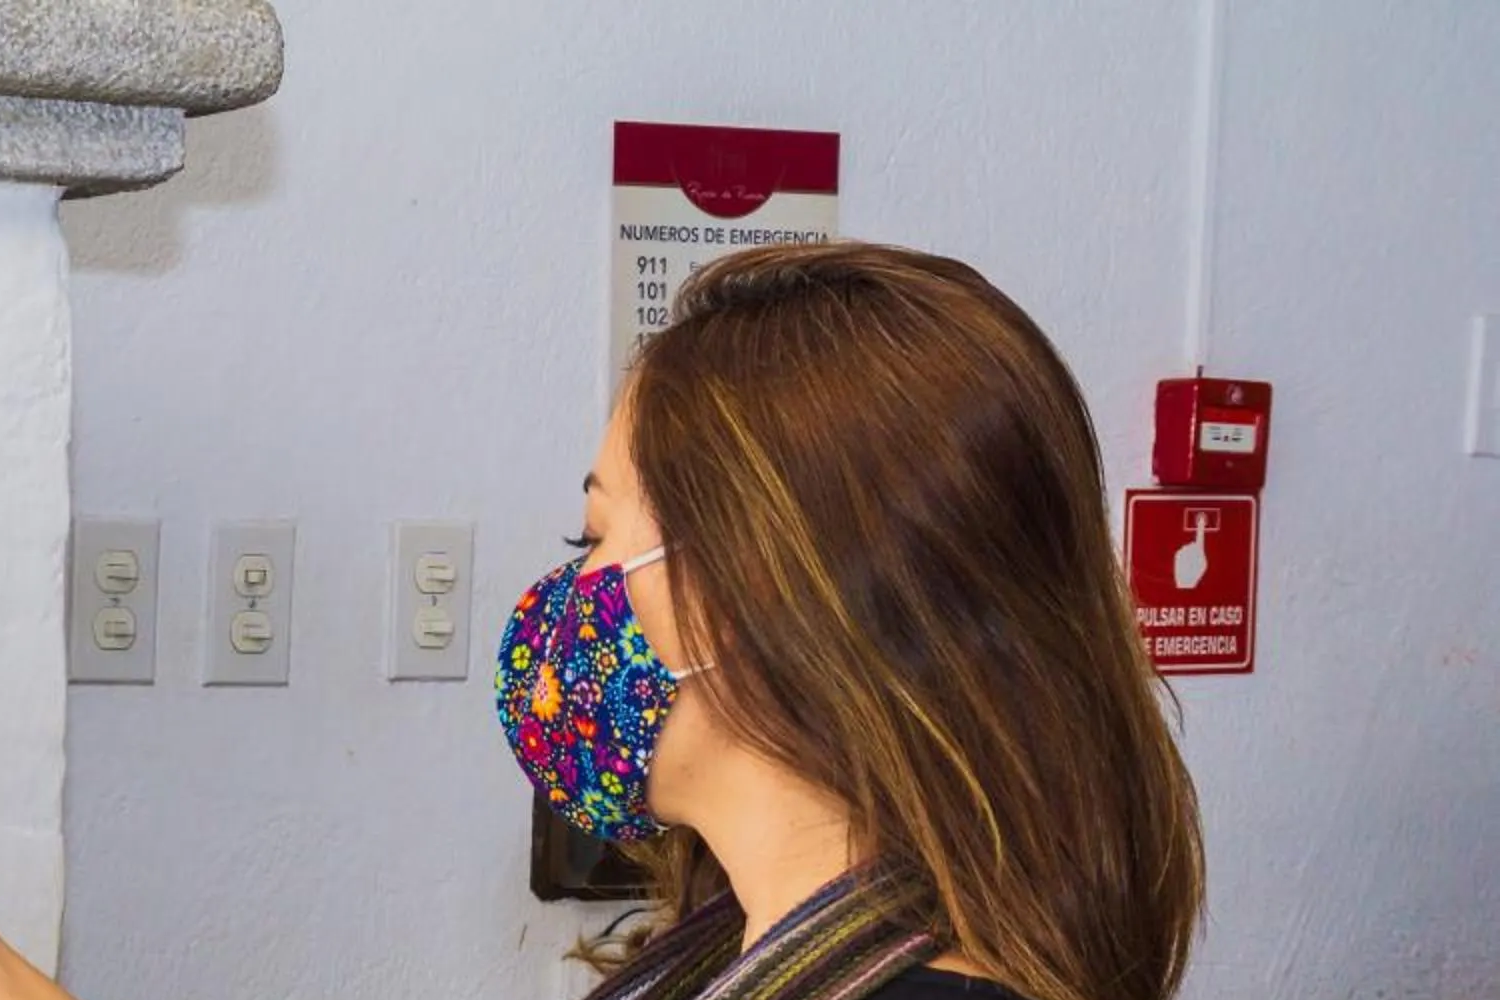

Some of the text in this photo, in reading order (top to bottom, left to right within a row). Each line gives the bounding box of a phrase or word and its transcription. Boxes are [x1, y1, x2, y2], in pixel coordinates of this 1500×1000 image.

[619, 224, 829, 245] NUMEROS DE EMERGENCIA
[637, 256, 667, 274] 911
[637, 282, 667, 300] 101
[637, 307, 668, 325] 102
[1136, 606, 1243, 626] PULSAR EN CASO
[1155, 636, 1238, 656] EMERGENCIA
